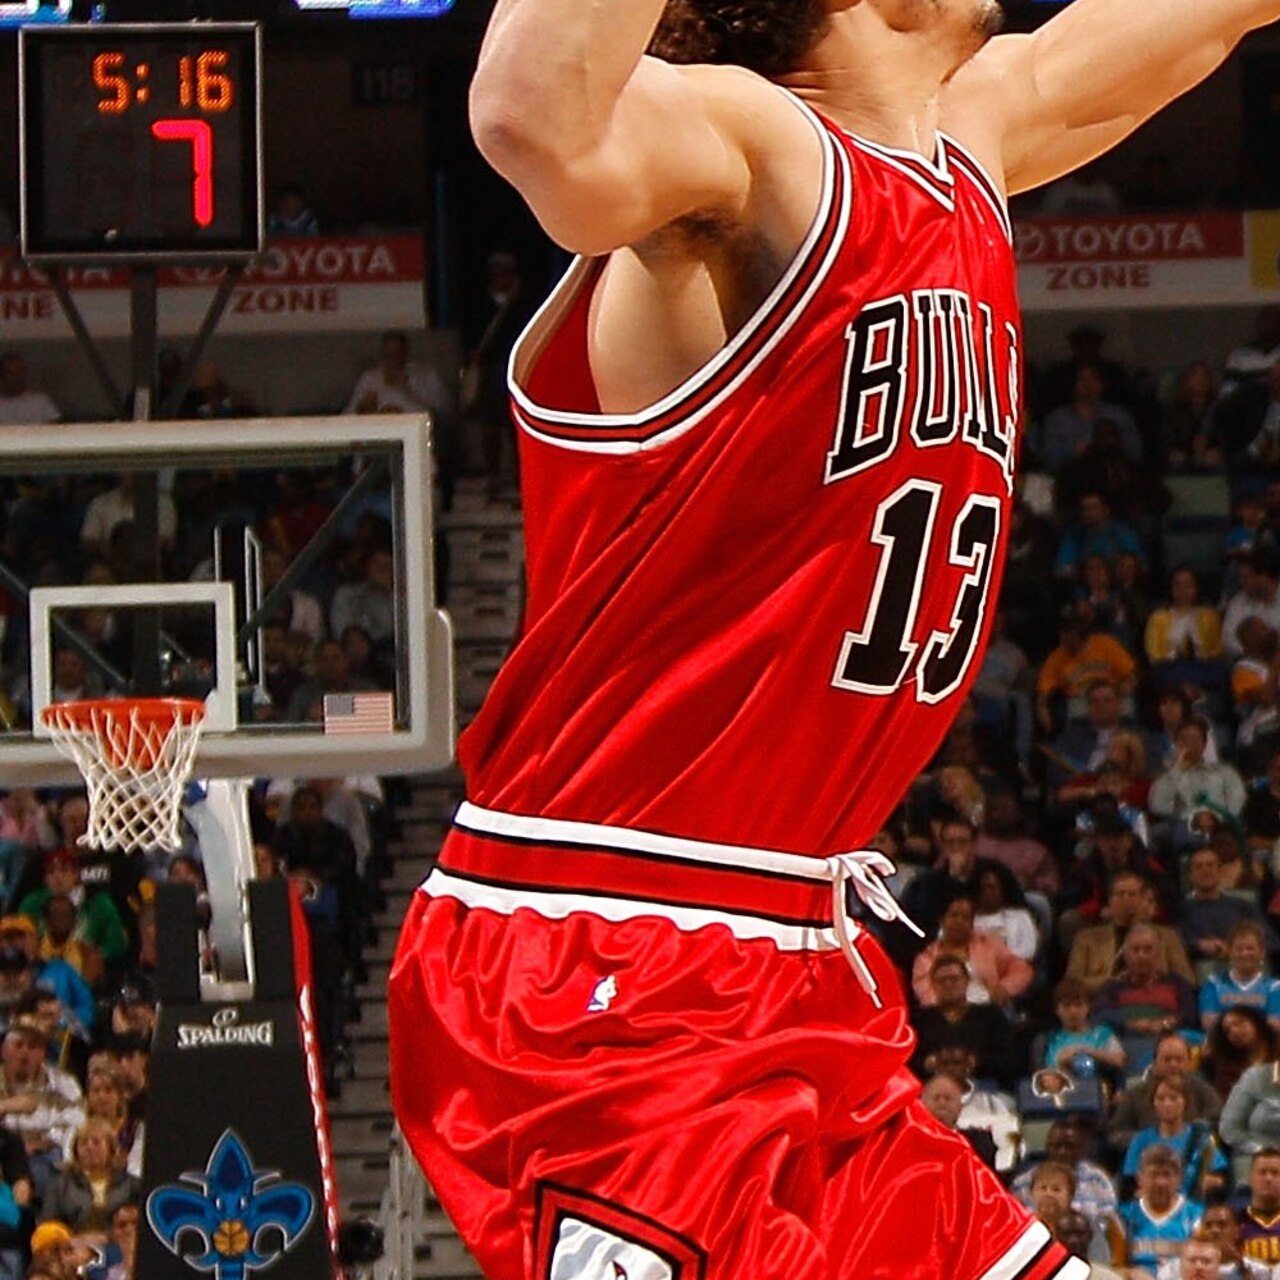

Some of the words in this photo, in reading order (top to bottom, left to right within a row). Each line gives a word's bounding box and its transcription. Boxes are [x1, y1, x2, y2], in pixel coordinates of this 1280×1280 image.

[92, 51, 235, 113] 5:16
[152, 119, 213, 226] 7
[1052, 222, 1205, 255] TOYOTA
[1047, 266, 1150, 290] ZONE
[3, 295, 54, 319] NE
[233, 287, 338, 313] ZONE
[824, 290, 1018, 496] BULL
[832, 478, 1000, 704] 13
[177, 1021, 273, 1049] SPALDING
